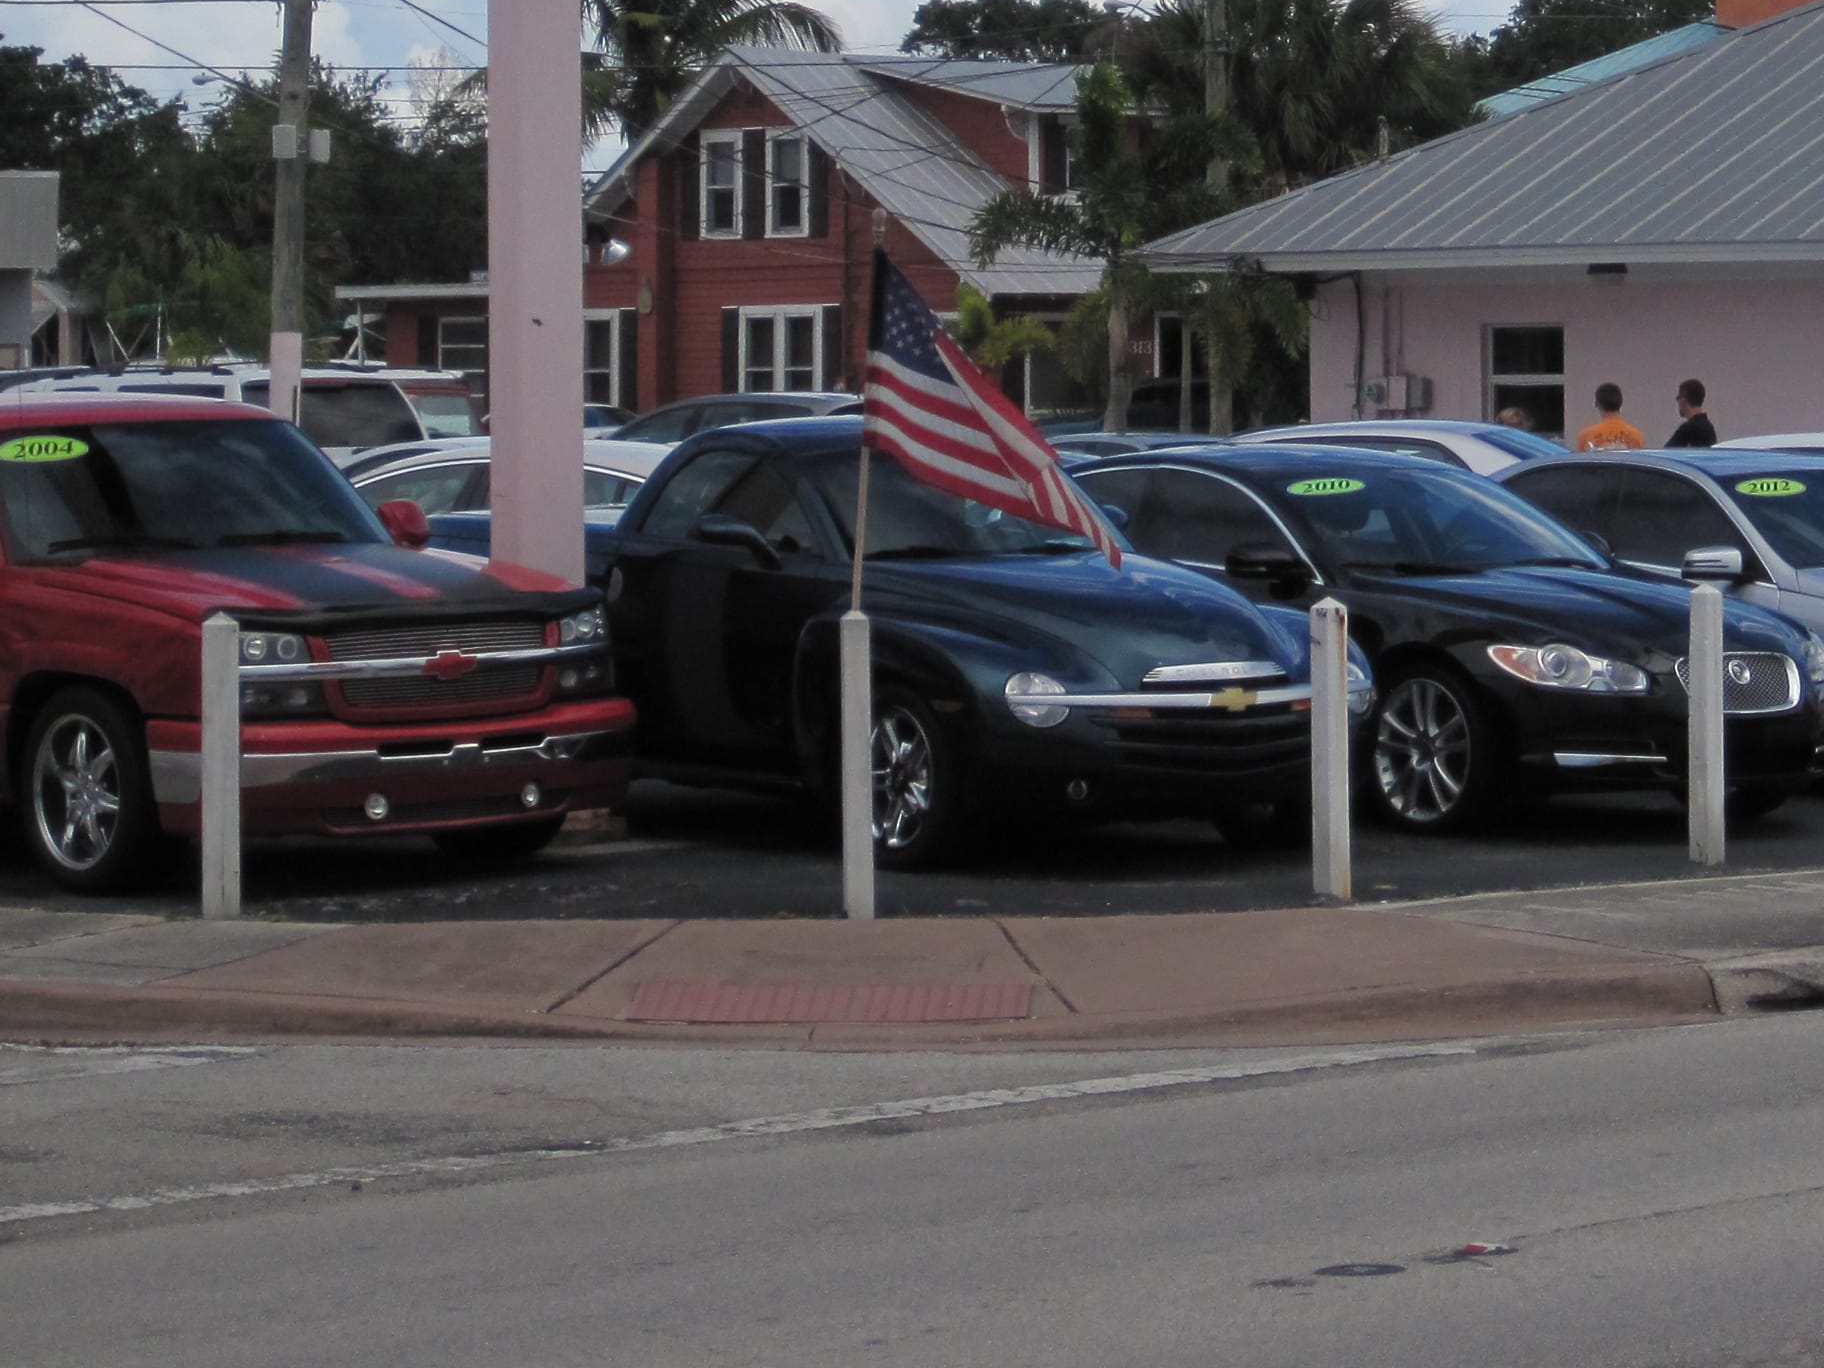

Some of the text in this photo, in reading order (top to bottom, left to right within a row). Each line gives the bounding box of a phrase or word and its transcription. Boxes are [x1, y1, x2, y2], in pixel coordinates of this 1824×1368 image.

[14, 440, 73, 458] 2004
[1303, 479, 1351, 493] 2010
[1748, 480, 1791, 493] 2012
